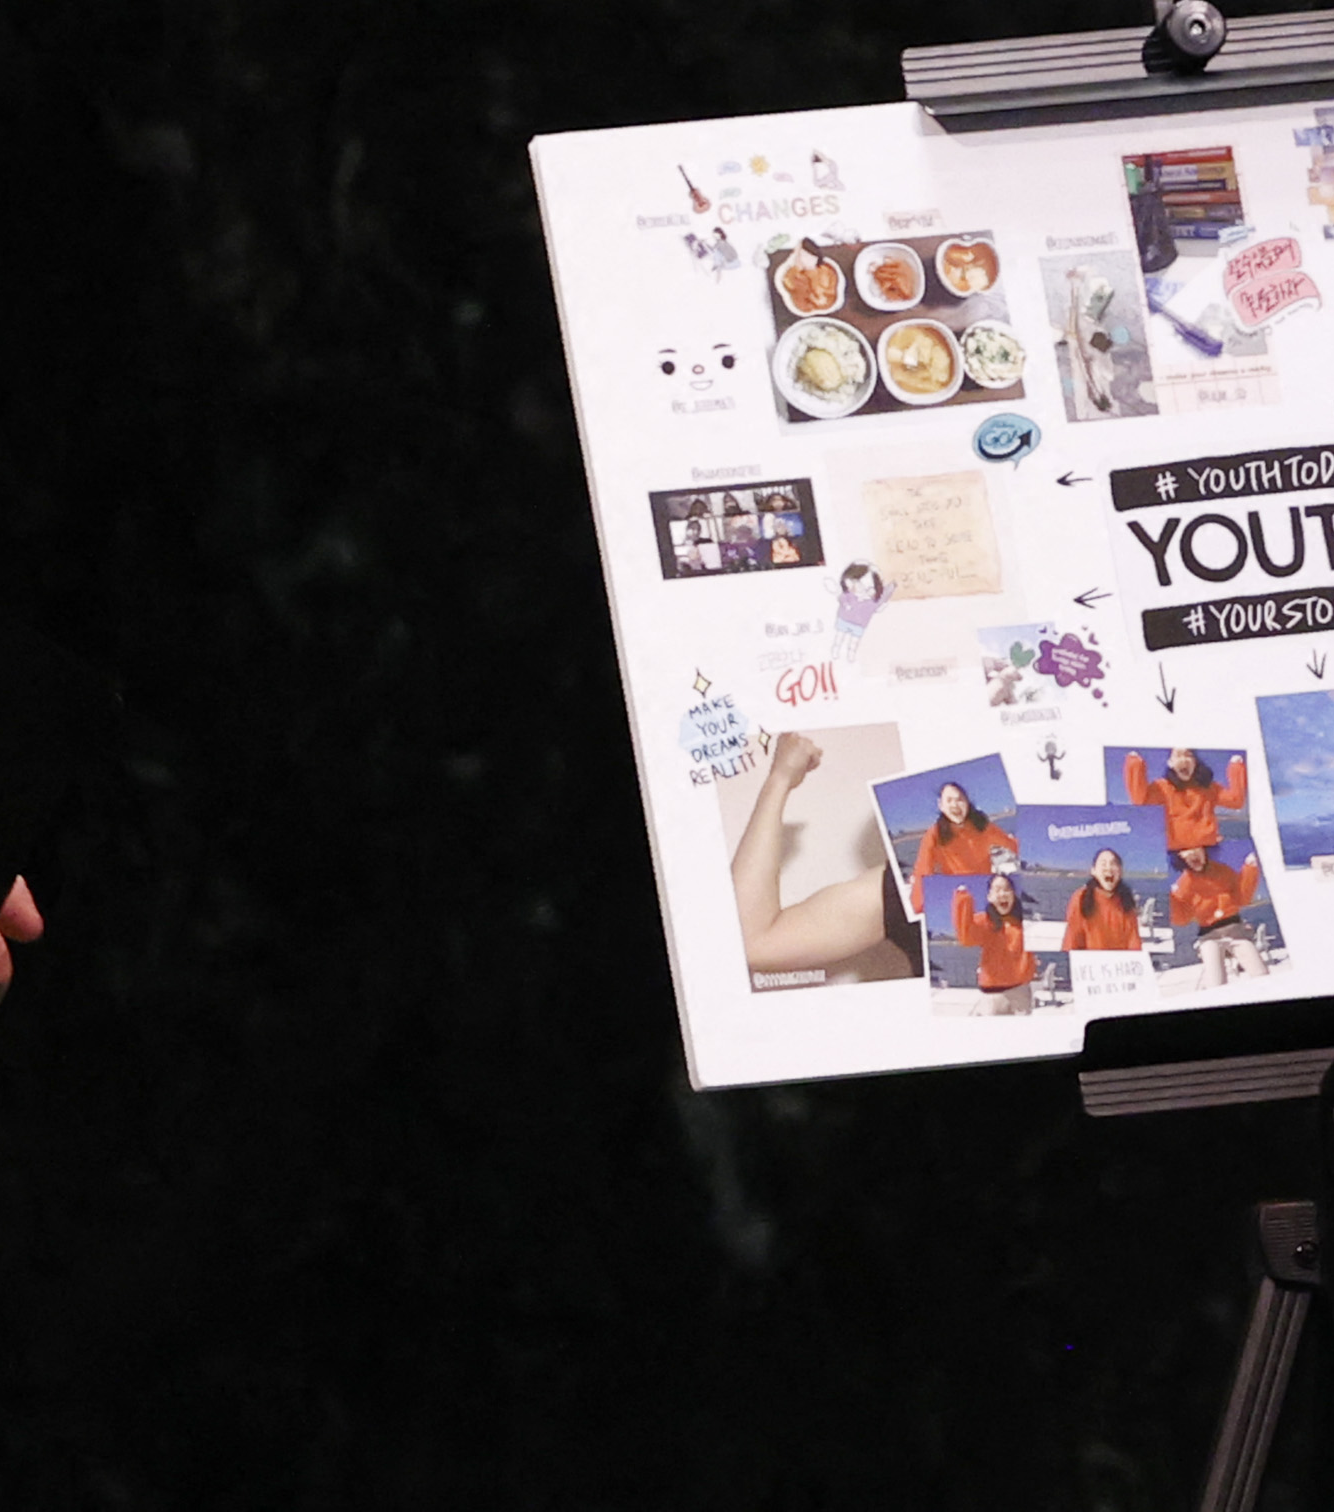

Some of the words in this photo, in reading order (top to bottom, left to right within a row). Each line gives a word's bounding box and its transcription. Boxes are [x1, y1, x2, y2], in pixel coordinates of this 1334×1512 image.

[717, 194, 840, 225] CHANGES
[775, 660, 839, 707] GO!!
[688, 693, 736, 720] MAKE
[695, 712, 739, 738] YOUR
[690, 732, 749, 763] DREAMS
[689, 749, 757, 788] REALITY
